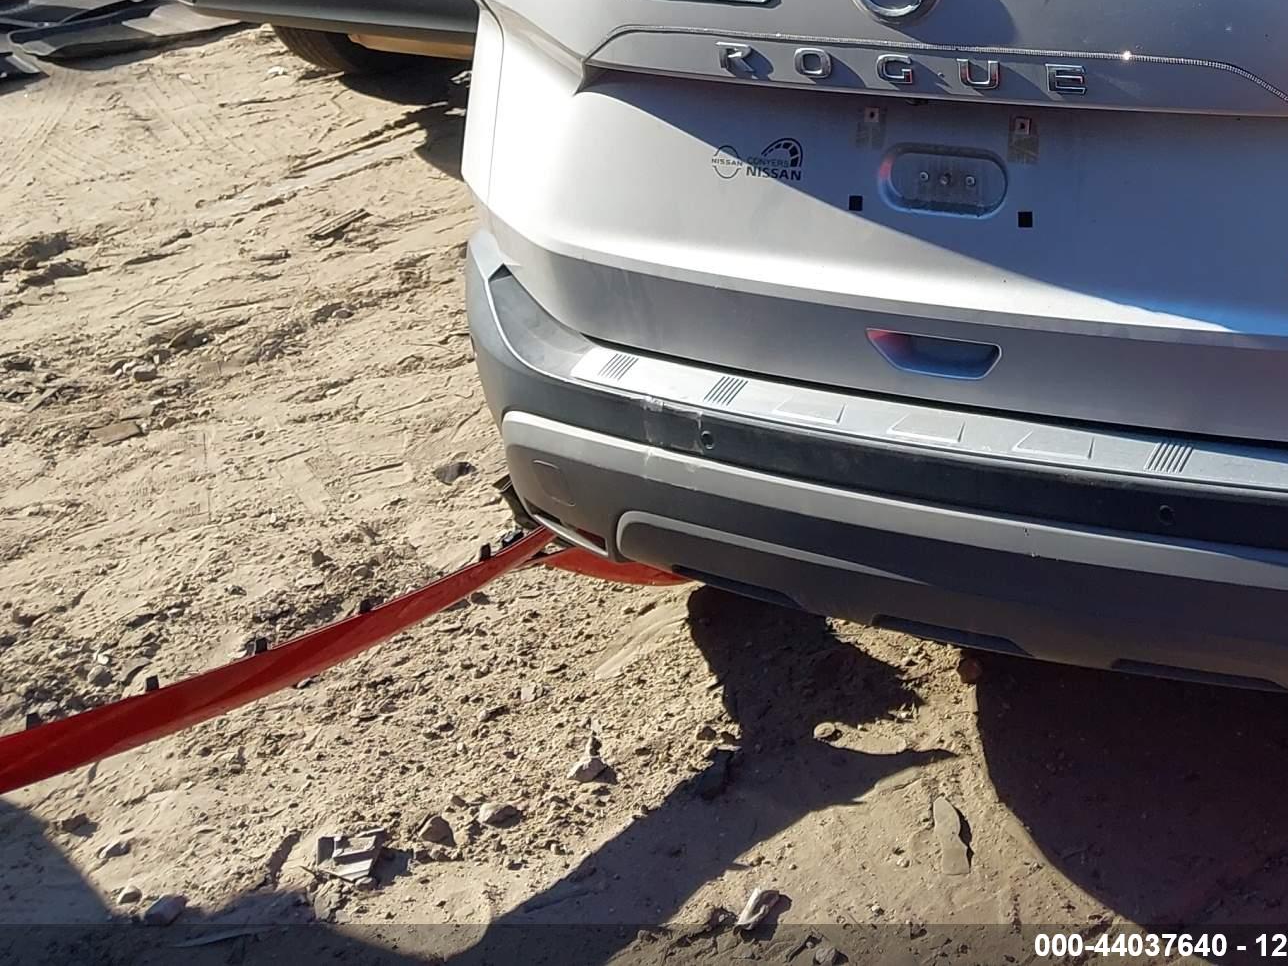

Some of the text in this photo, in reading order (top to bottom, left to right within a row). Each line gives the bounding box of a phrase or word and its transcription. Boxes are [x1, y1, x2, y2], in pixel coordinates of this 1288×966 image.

[715, 41, 1088, 95] ROGUE
[711, 157, 743, 167] NISSAN
[747, 156, 789, 168] CONYERS
[746, 166, 802, 181] NISSAN
